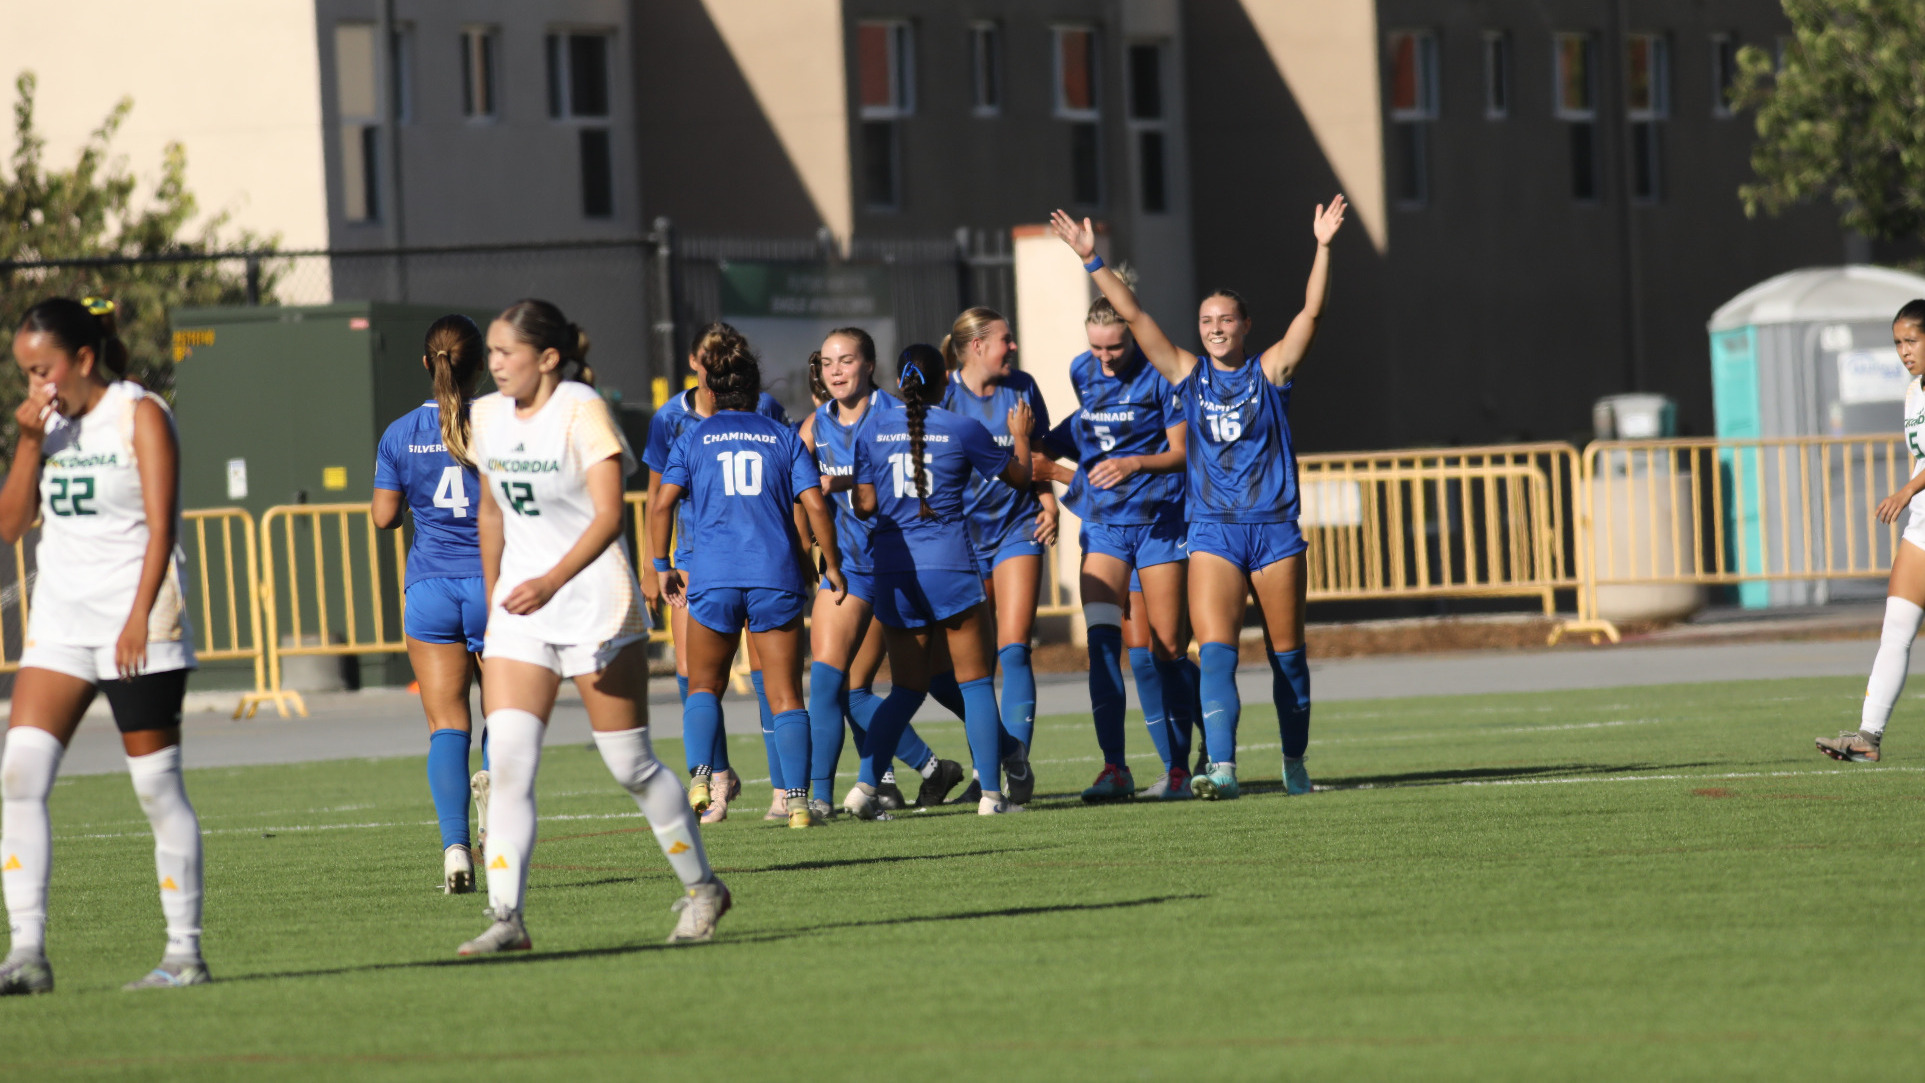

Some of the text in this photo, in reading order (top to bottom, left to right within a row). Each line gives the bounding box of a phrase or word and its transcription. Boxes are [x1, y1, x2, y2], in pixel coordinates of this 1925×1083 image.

[1081, 409, 1135, 422] AMINADE
[1206, 411, 1241, 442] 16
[408, 444, 448, 453] SILVERS
[703, 431, 777, 445] CHAMINADE
[877, 431, 949, 442] SILVERSORDS
[1094, 425, 1116, 451] 5
[716, 450, 763, 496] 10
[888, 453, 933, 498] 15
[50, 477, 97, 516] 22
[433, 466, 470, 518] 4
[501, 481, 541, 516] 12
